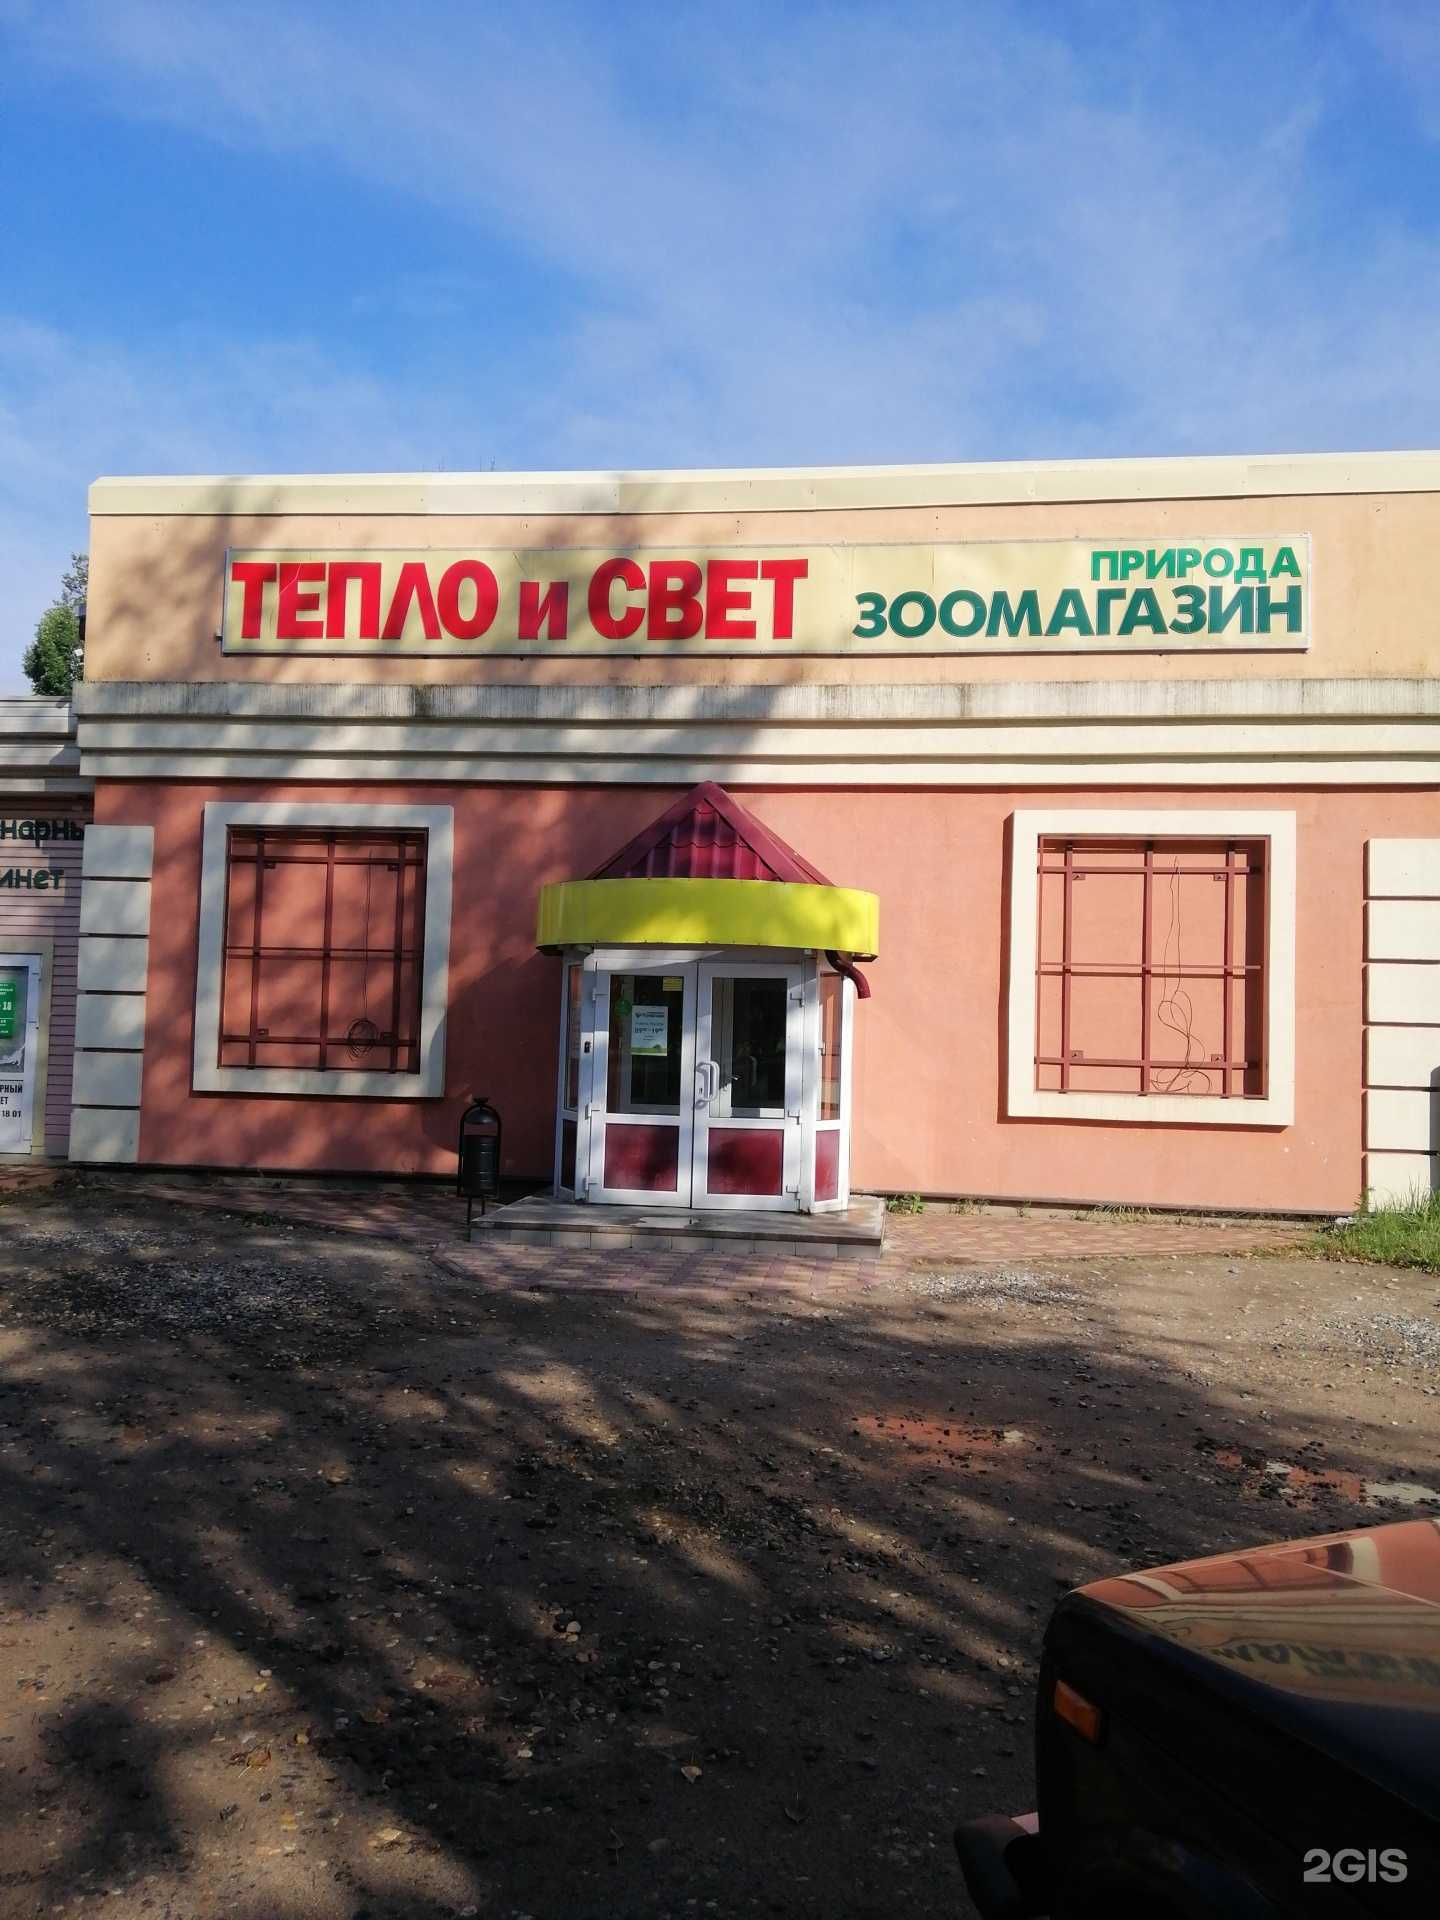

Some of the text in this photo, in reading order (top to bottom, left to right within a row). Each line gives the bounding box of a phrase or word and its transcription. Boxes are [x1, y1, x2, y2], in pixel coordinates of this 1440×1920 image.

[1090, 546, 1302, 582] ПРИРОДА
[231, 557, 809, 641] ТЕПЛО и СВЕТ
[852, 584, 1302, 639] ЗООМАГАЗИН
